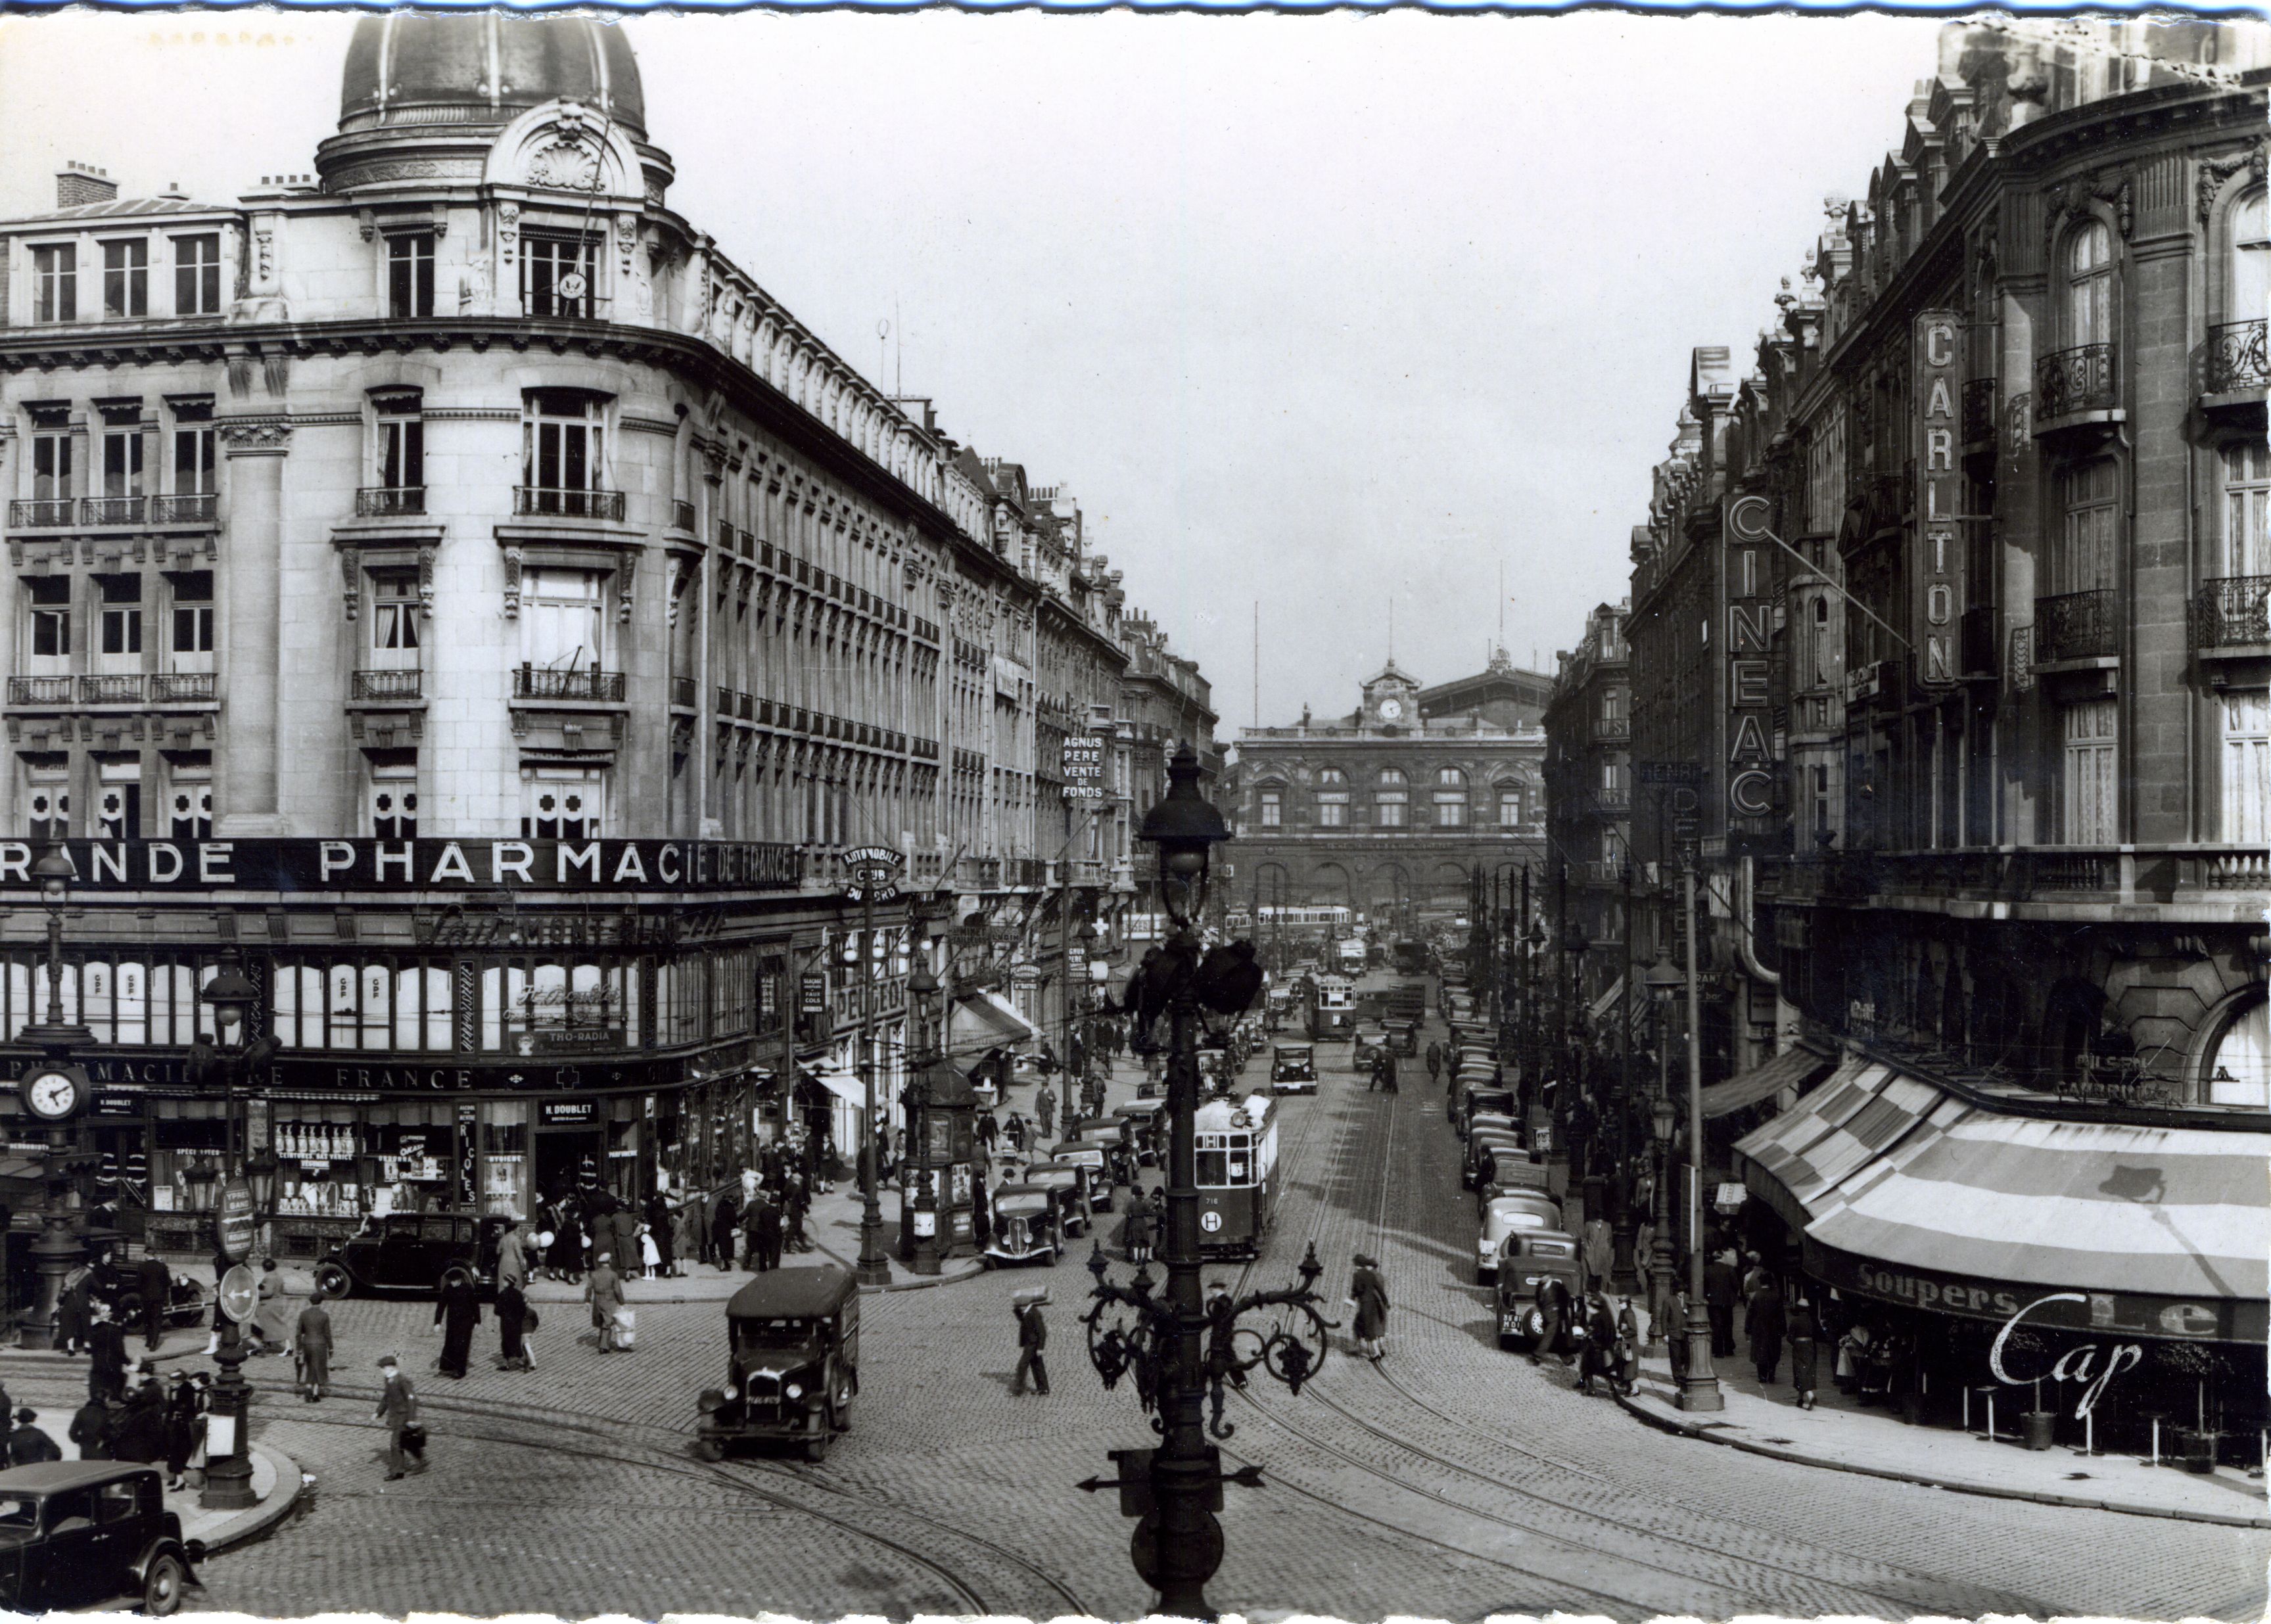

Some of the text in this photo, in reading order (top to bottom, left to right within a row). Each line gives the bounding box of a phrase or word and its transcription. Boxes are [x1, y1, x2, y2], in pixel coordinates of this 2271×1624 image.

[1925, 325, 1955, 684] CARLTON
[1729, 496, 1771, 817] CINEAC
[1063, 737, 1102, 748] AGNUS
[1064, 751, 1100, 762] PERE
[1062, 766, 1102, 777] VENTE
[1062, 787, 1103, 798] FONDS
[319, 841, 707, 884] PHARMACIE
[718, 845, 734, 882] DE
[743, 845, 790, 882] FRANCE
[845, 848, 901, 866] AUTOMOBILE
[550, 1031, 610, 1042] THO-RADIA
[337, 1069, 471, 1088] FRANCE
[546, 1104, 592, 1115] H. DOUBLET
[1206, 1136, 1217, 1148] H
[226, 1191, 248, 1201] YPRES
[1206, 1215, 1217, 1229] H
[1858, 1263, 2021, 1316] Soupers
[2089, 1293, 2218, 1335] Le
[1989, 1292, 2143, 1420] Cap
